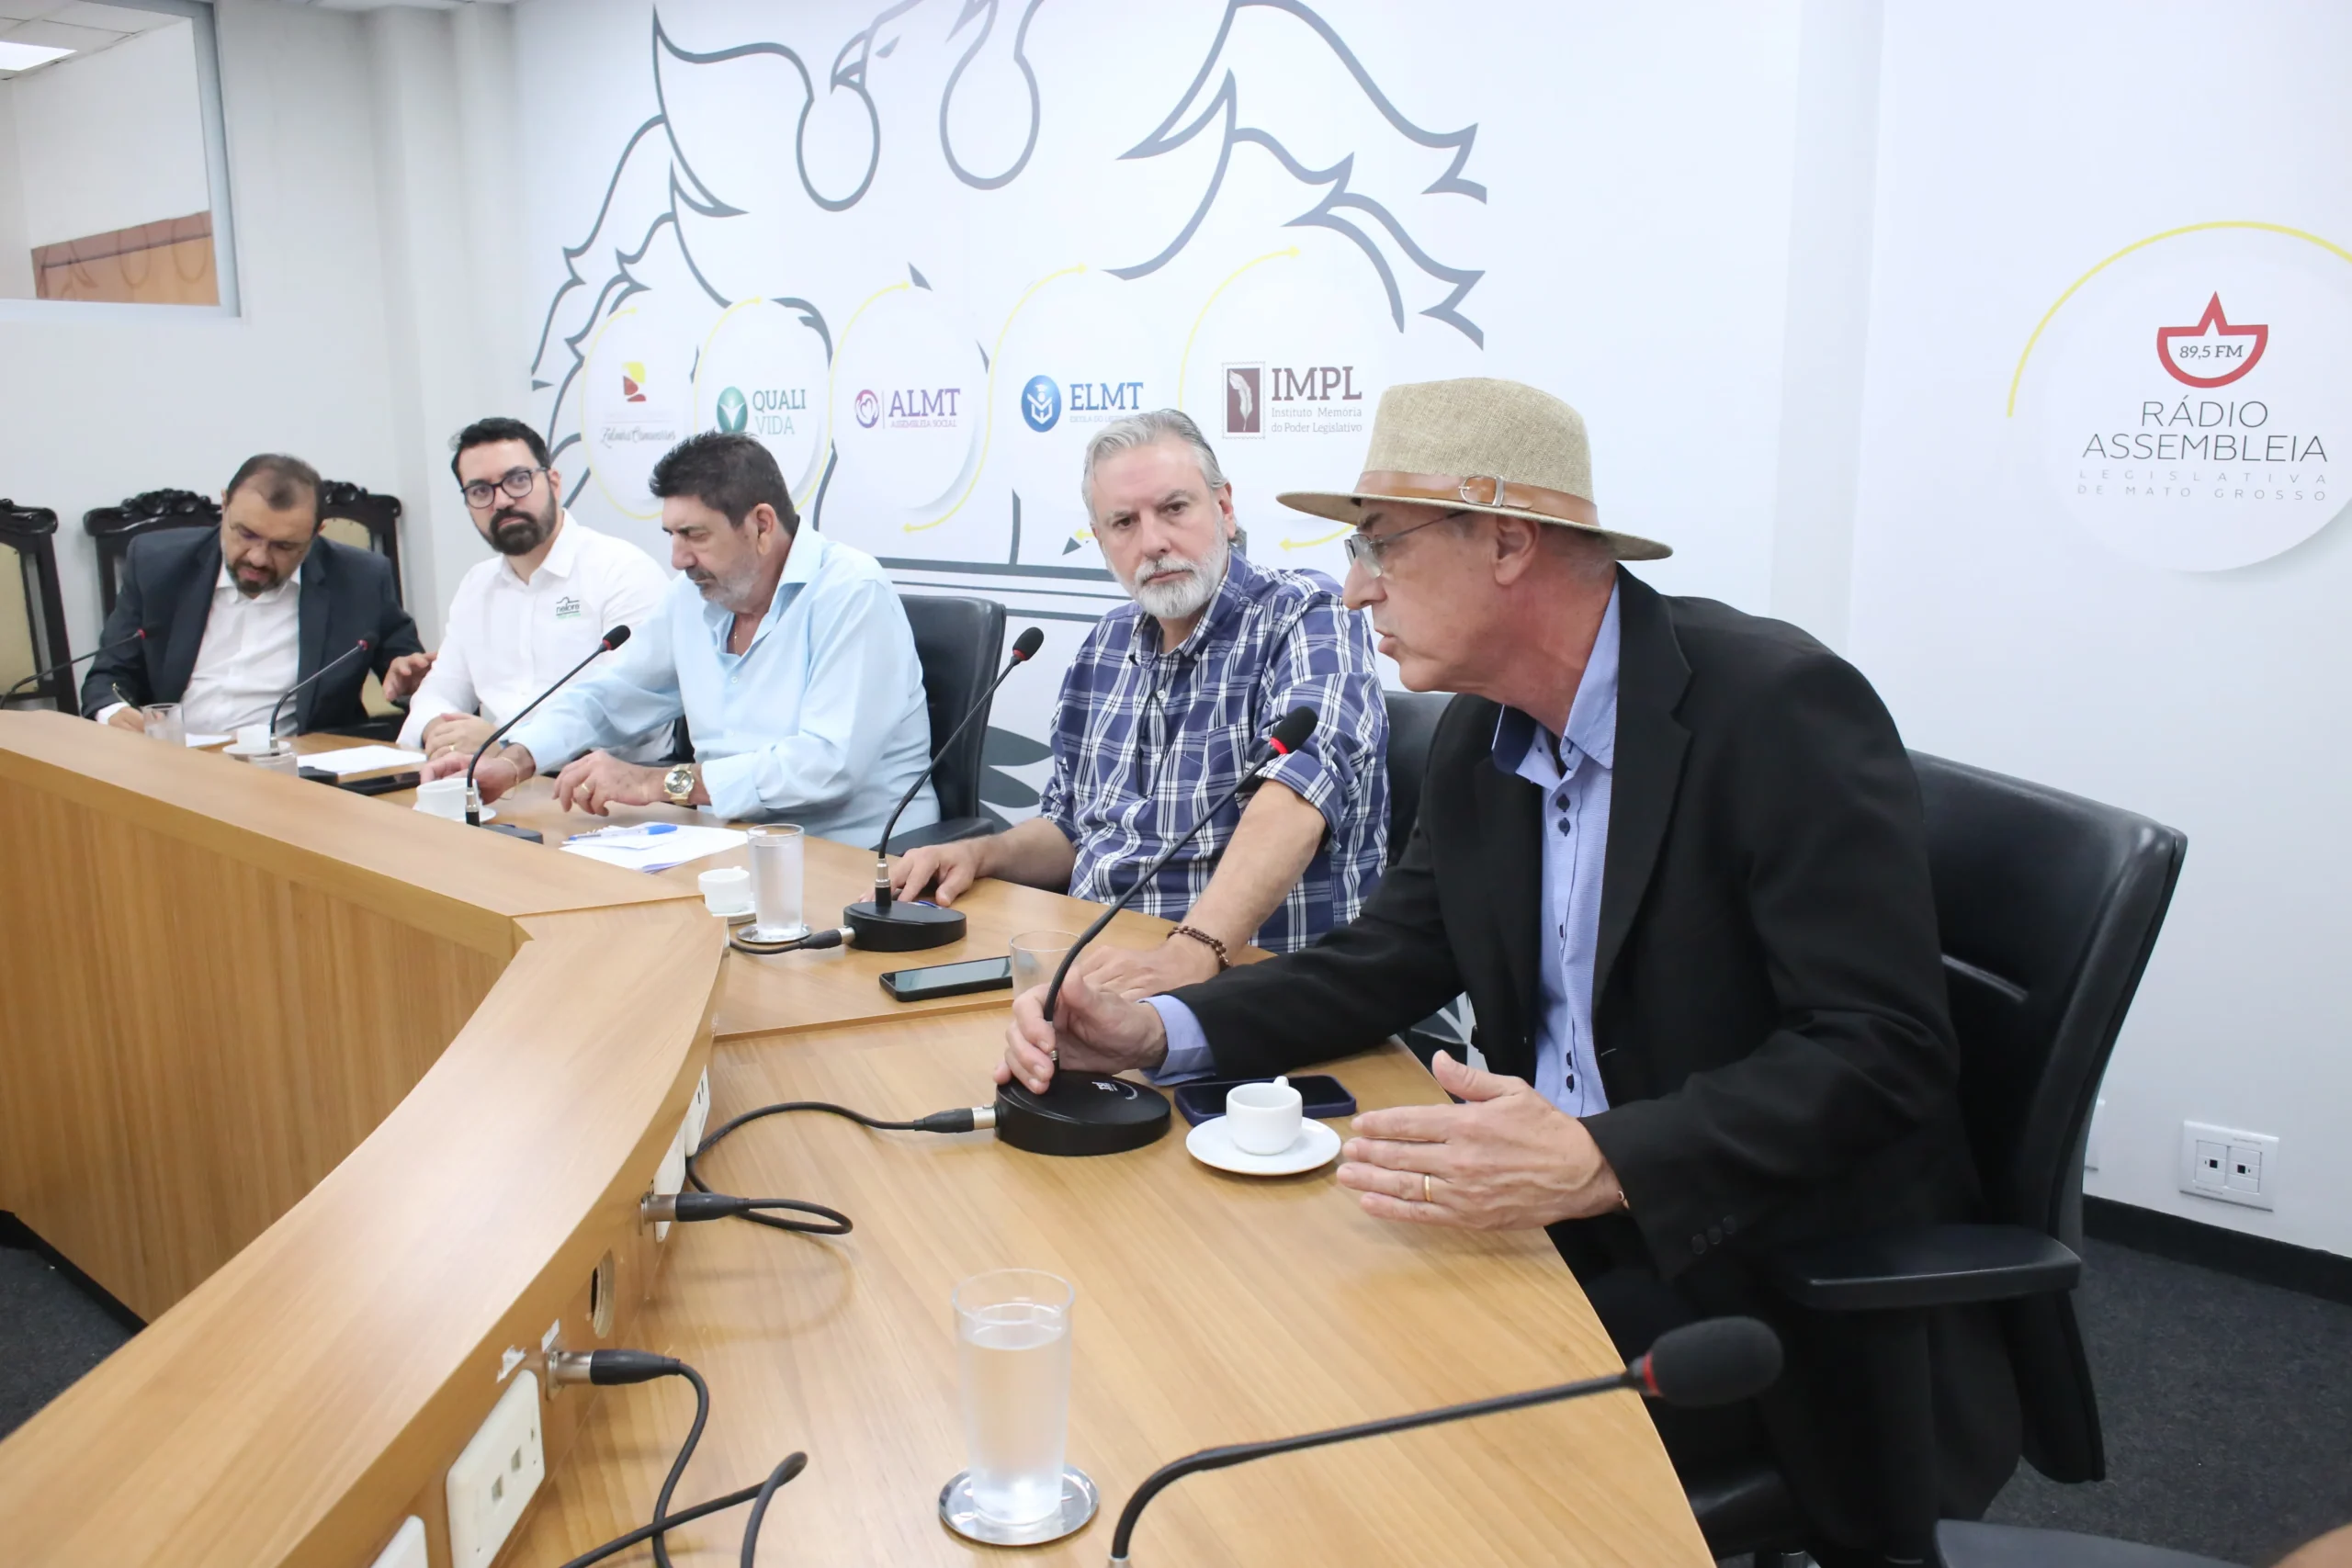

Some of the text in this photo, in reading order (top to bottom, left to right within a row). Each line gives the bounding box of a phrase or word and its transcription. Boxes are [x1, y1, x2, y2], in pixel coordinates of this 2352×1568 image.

[2178, 344, 2244, 360] 89,5 FM
[1272, 367, 1363, 400] IMPL
[752, 389, 807, 413] QUALI
[888, 388, 961, 418] ALMT
[1069, 382, 1144, 411] ELMT
[1272, 407, 1362, 417] Instituto Memória
[2142, 394, 2268, 428] RÁDIO
[755, 415, 795, 435] VIDA
[1272, 423, 1363, 434] do Poder Legislativo
[2082, 433, 2328, 463] ASSEMBLEIA
[2079, 469, 2326, 484] LEGISLATIVA
[2077, 485, 2325, 502] DE MATO GROSSO
